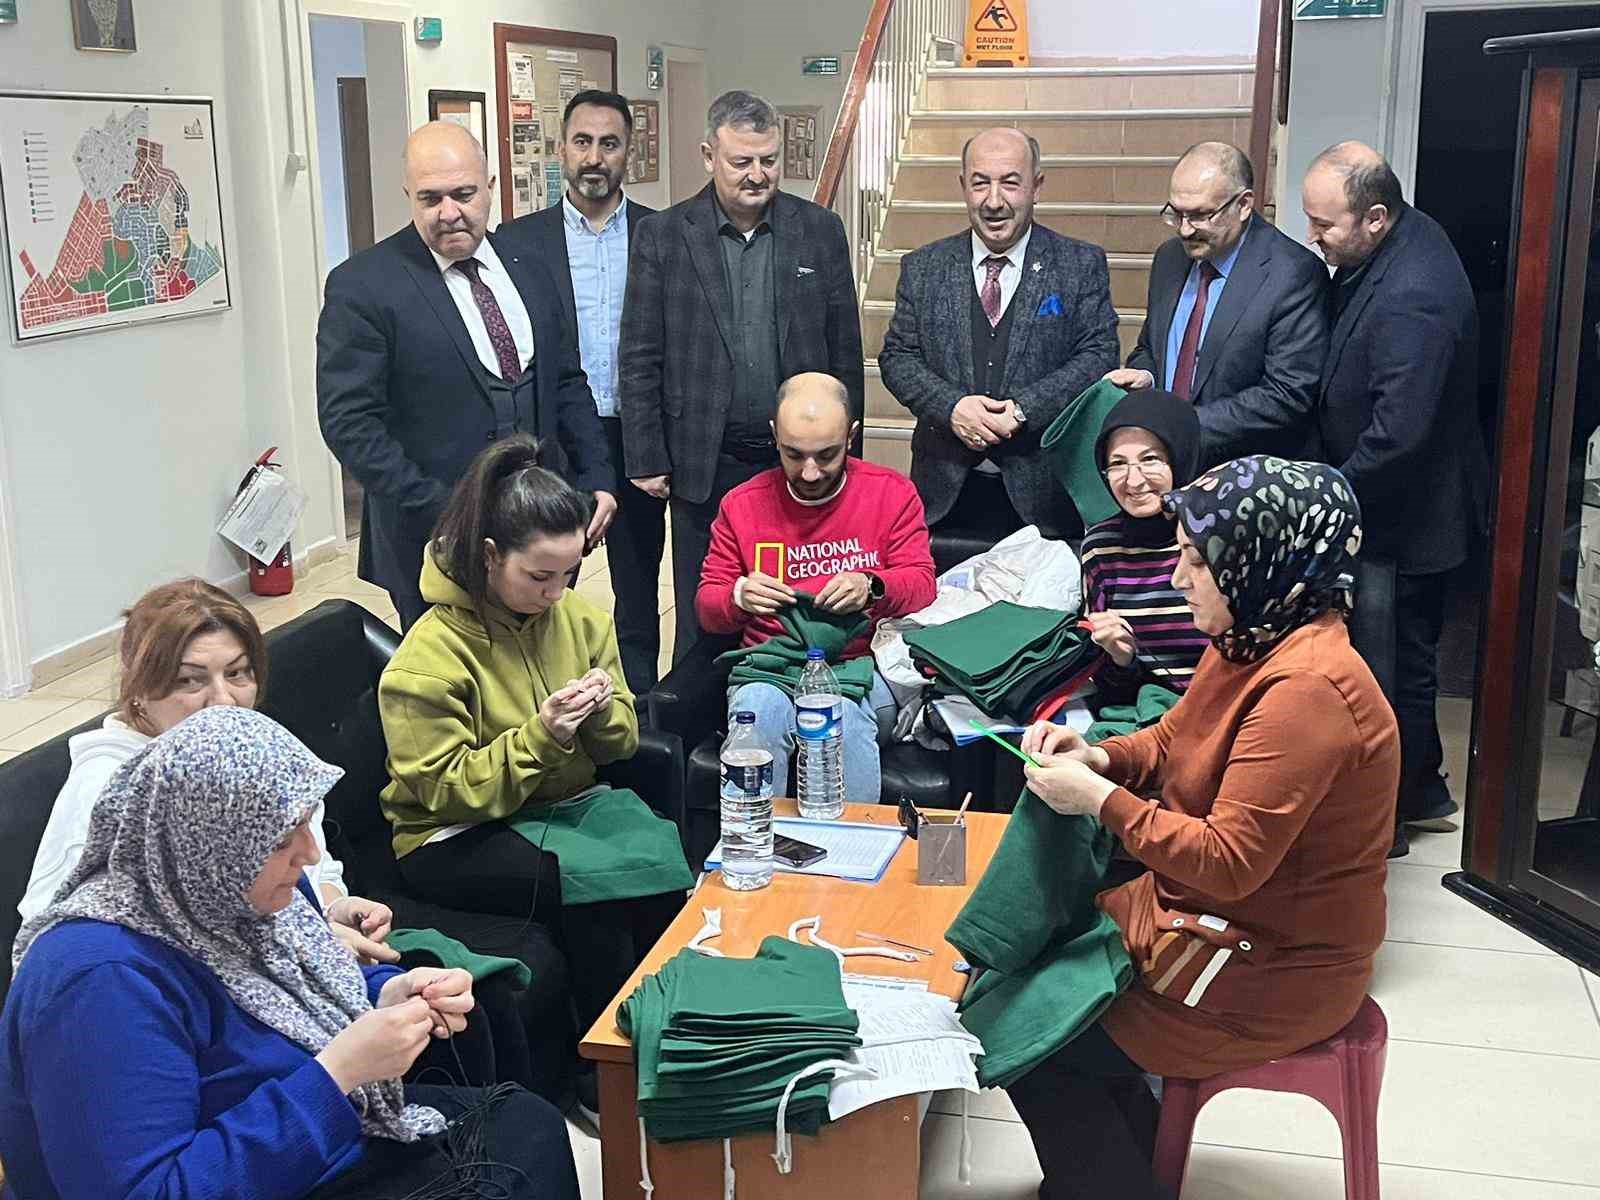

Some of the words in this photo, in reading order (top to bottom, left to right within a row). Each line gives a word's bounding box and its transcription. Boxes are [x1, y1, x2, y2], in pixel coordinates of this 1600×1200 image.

[976, 36, 1015, 44] CAUTION
[787, 538, 863, 561] NATIONAL
[787, 550, 880, 579] GEOGRAPHIC
